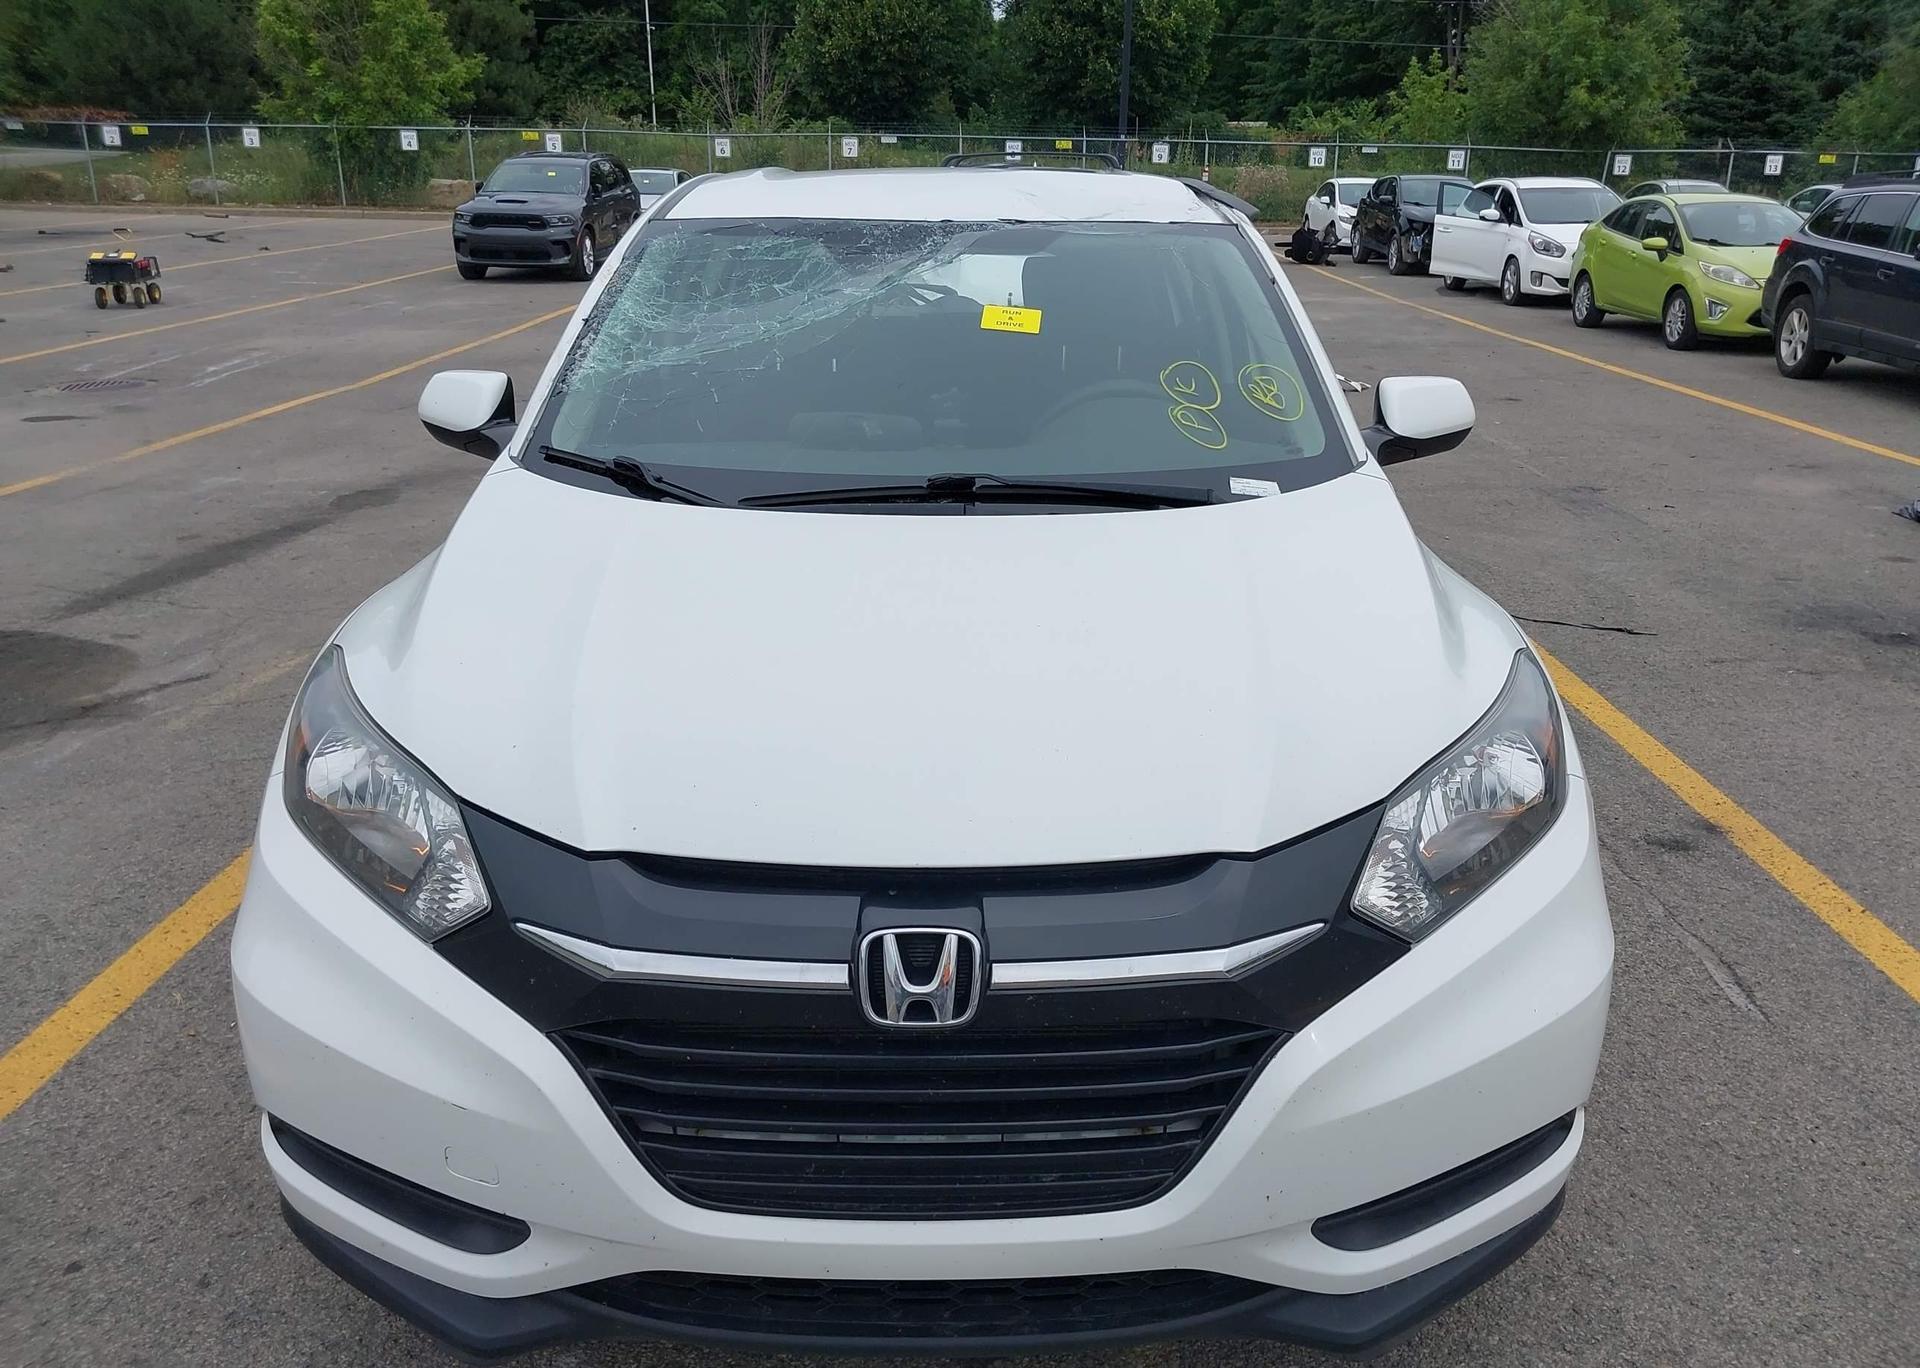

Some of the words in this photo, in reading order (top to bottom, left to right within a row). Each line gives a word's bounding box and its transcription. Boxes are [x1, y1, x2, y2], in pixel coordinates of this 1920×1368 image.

[110, 136, 116, 144] 2
[249, 138, 254, 146] 3
[552, 142, 556, 150] 5
[720, 147, 726, 155] 6
[847, 148, 853, 156] 7
[1312, 157, 1322, 165] 10
[1452, 160, 1460, 168] 11
[1617, 165, 1627, 173] 12
[1769, 164, 1778, 172] 13
[1174, 377, 1199, 396] K
[1177, 410, 1213, 431] P
